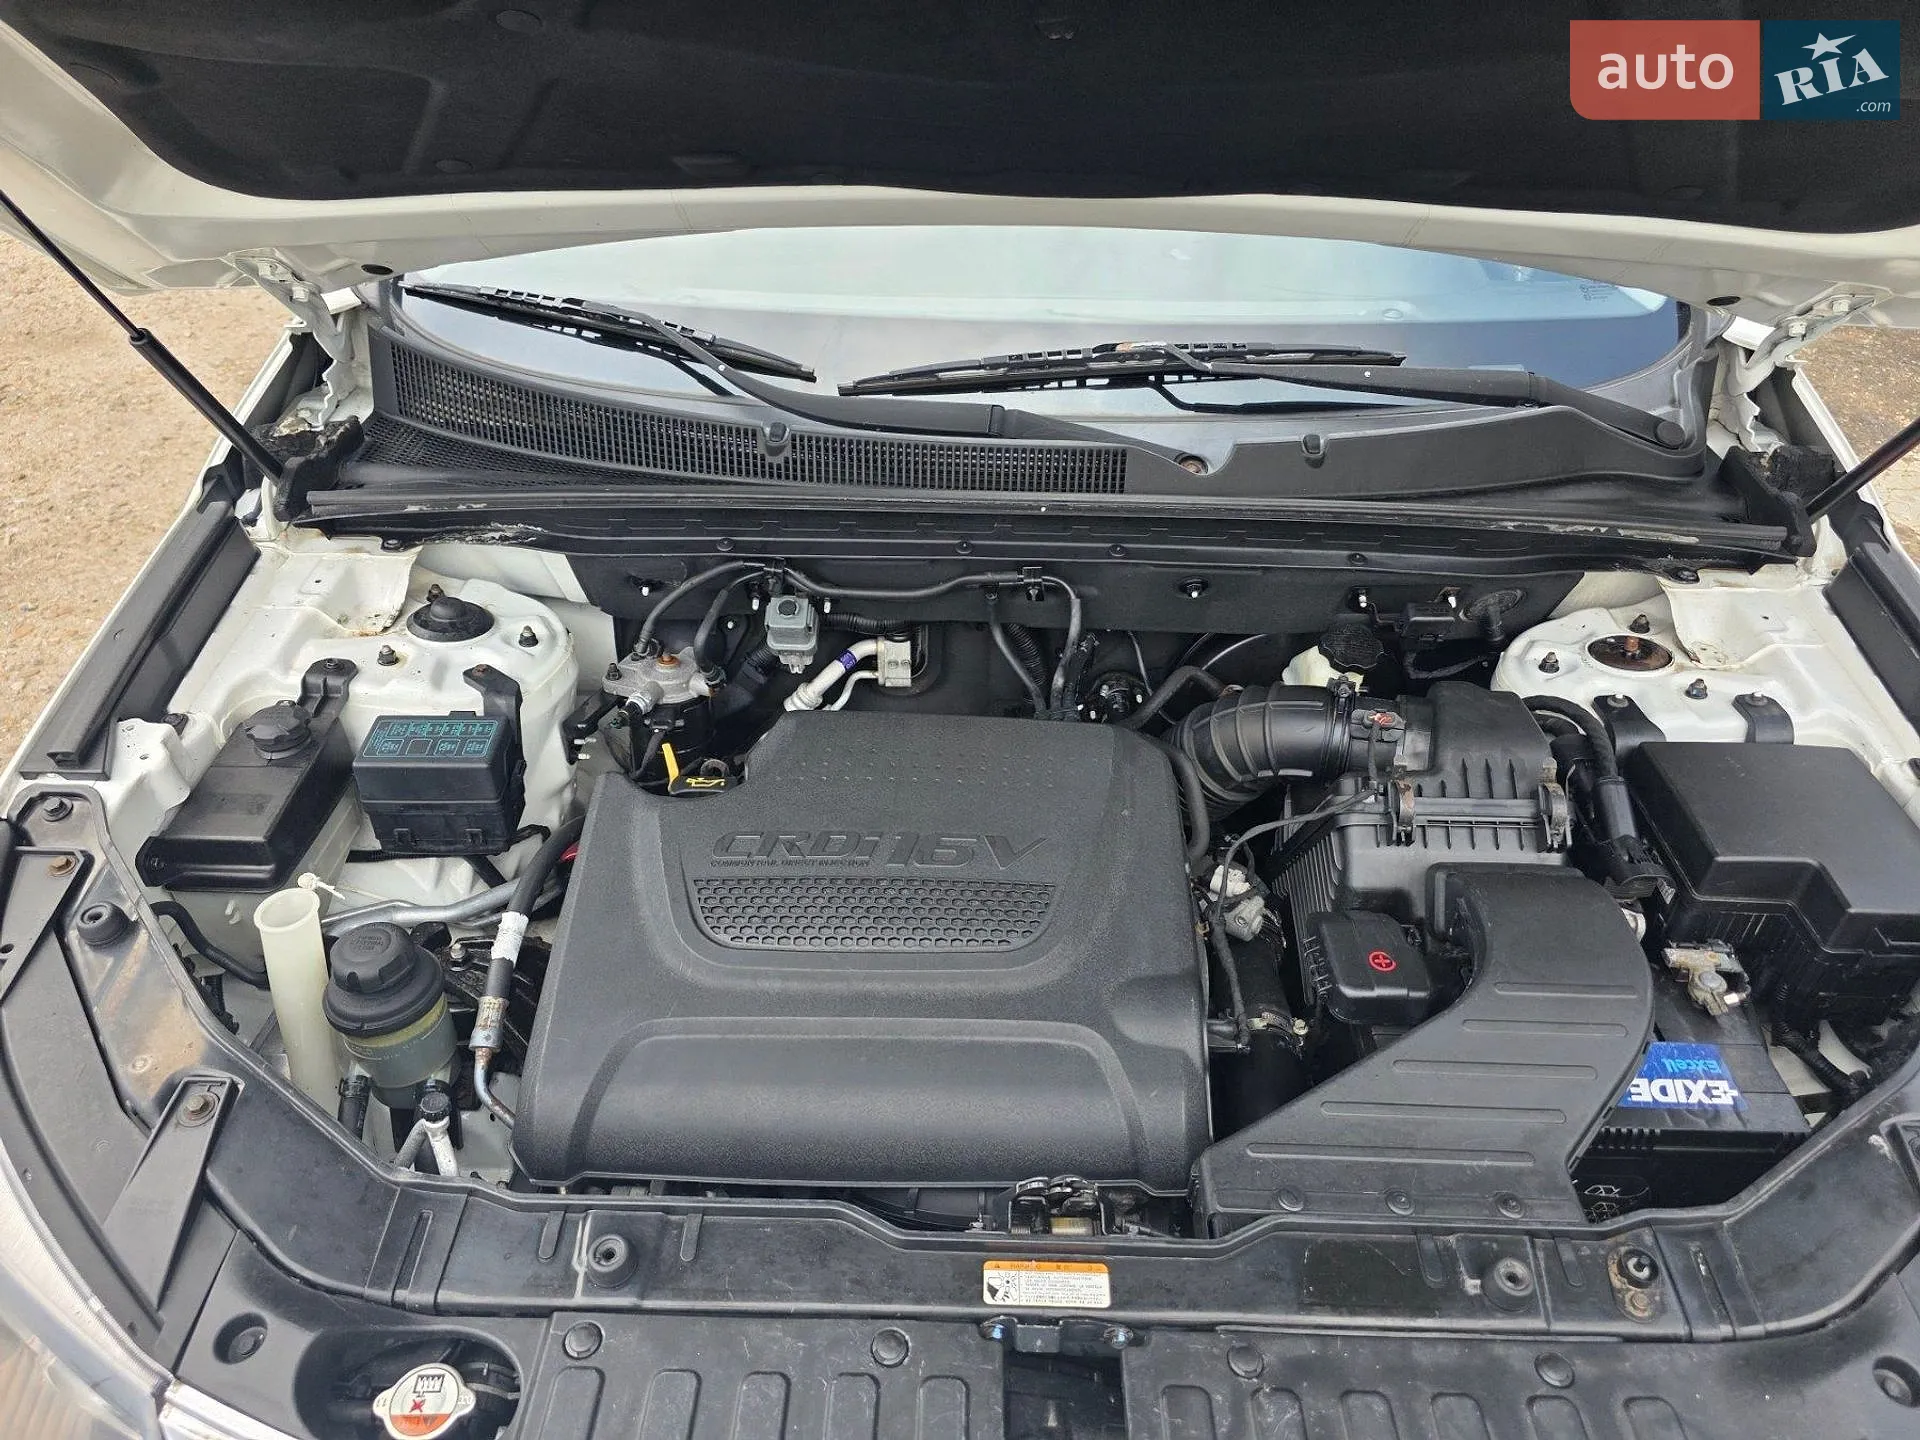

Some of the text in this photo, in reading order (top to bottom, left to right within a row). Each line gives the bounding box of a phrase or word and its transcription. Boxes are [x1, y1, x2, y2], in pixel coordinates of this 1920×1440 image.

[885, 831, 1050, 870] 16V
[1661, 1058, 1722, 1074] Excell
[1629, 1078, 1738, 1105] EXIDE
